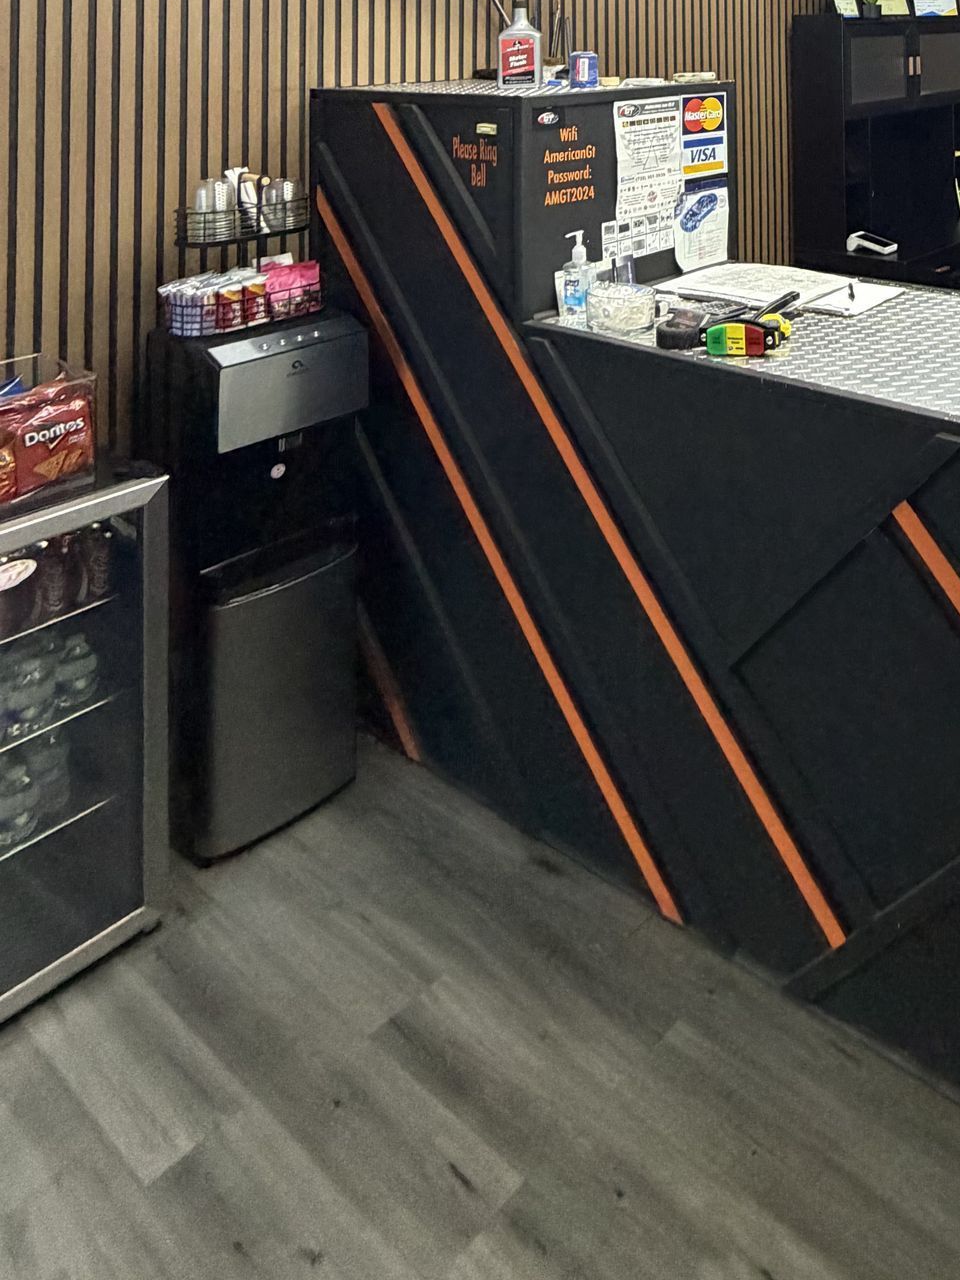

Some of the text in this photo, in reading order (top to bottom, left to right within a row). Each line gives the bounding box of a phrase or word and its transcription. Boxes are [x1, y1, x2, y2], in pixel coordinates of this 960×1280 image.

[684, 109, 721, 121] MasterCard
[559, 126, 578, 142] Wifi
[452, 136, 498, 167] Please Ring
[690, 147, 717, 163] VISA
[471, 163, 487, 187] Bell
[547, 164, 592, 184] Password:
[544, 186, 595, 207] AMGT2024
[24, 417, 85, 447] Doritos
